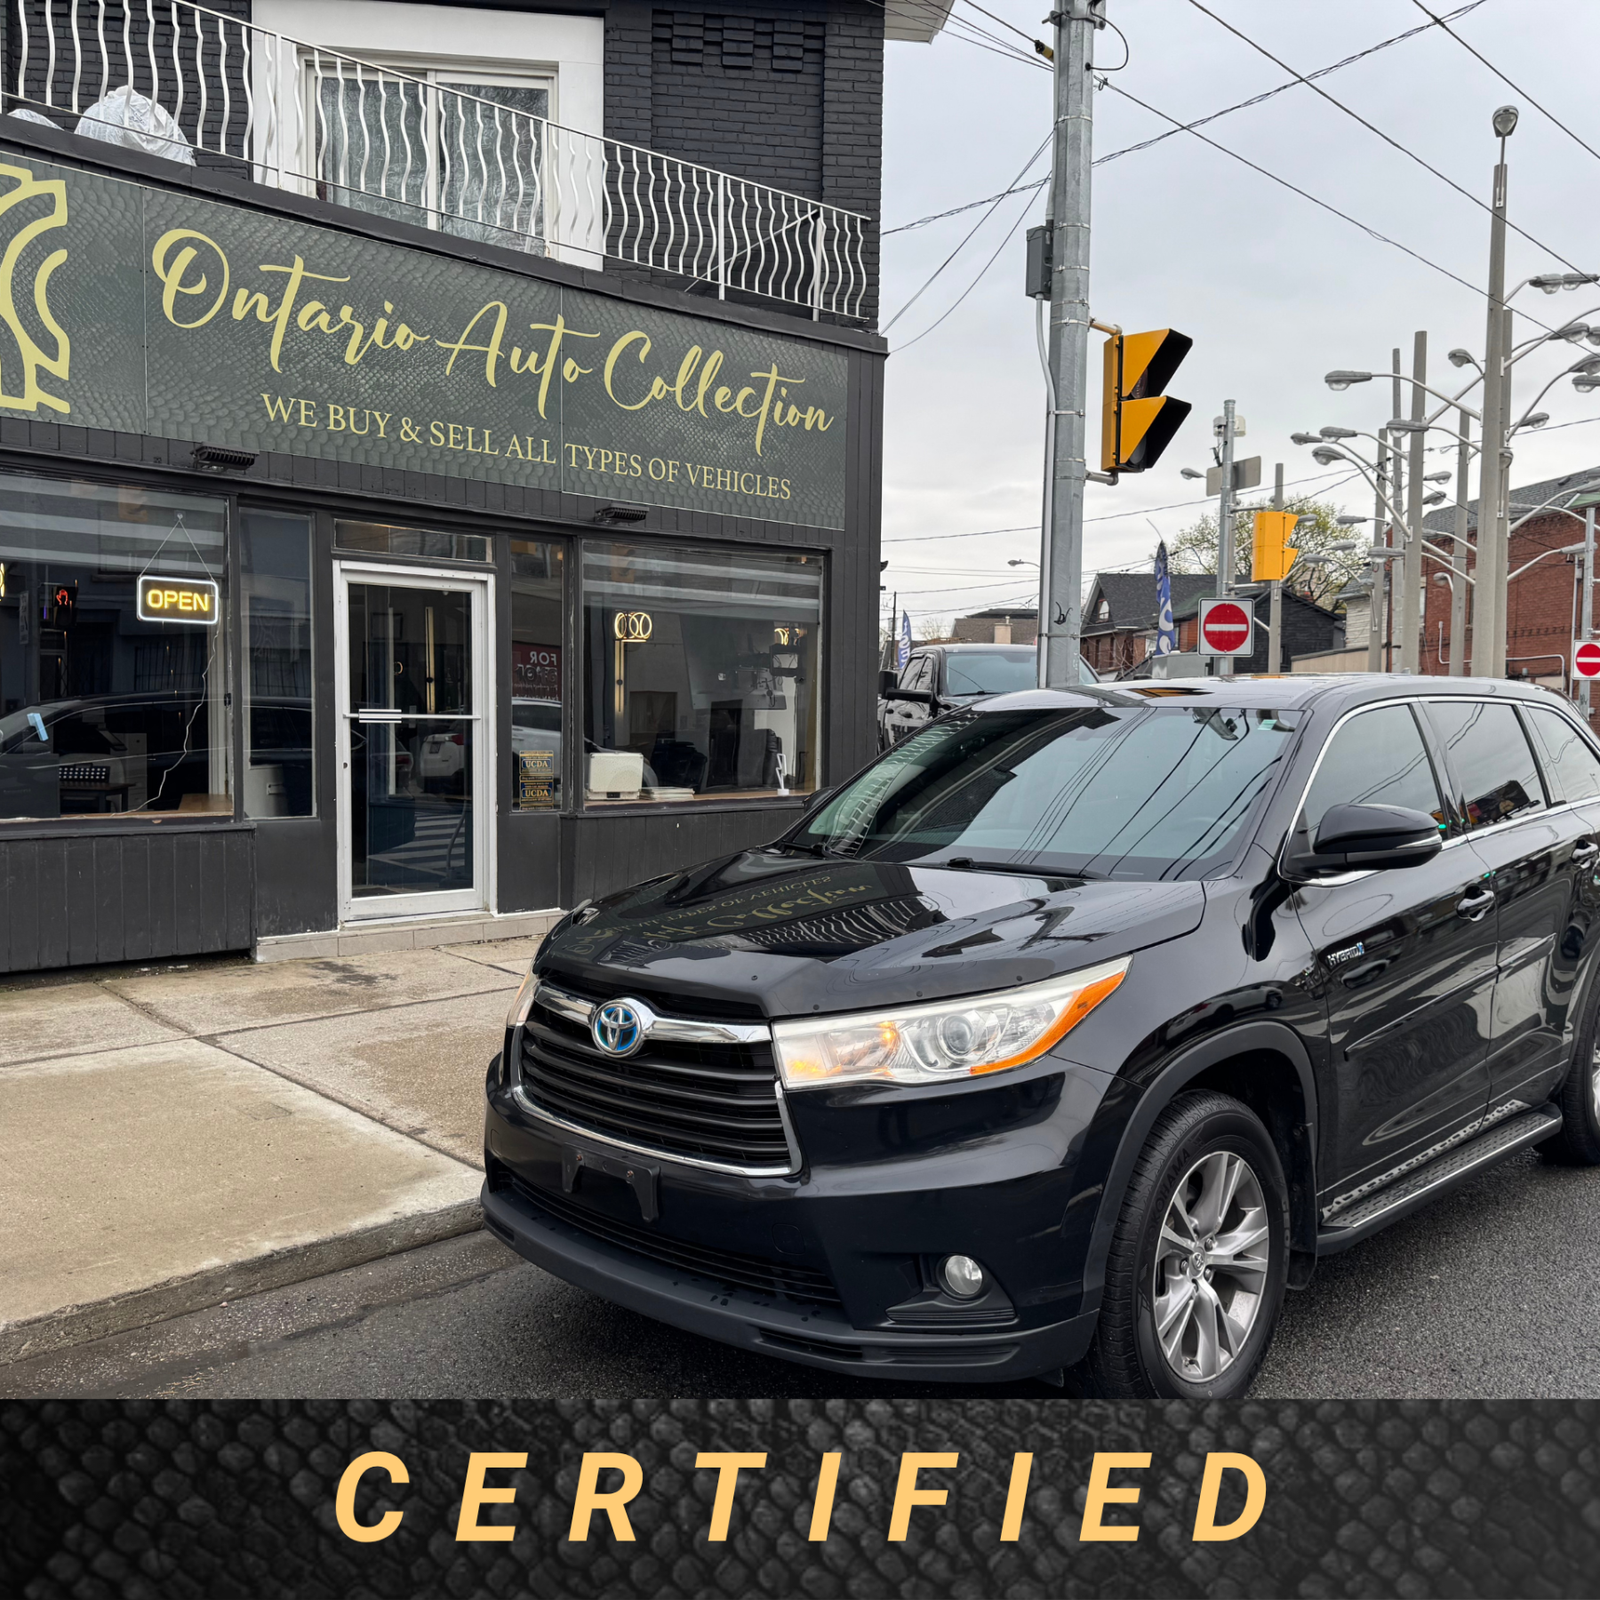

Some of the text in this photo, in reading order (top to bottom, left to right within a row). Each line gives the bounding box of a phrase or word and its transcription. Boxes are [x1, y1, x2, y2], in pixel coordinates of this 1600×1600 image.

[152, 228, 834, 457] Ontario Auto Collection
[262, 393, 791, 500] WE BUY & SELL ALL TYPES OF VEHICLES
[146, 588, 210, 612] OPEN
[525, 760, 549, 768] UCDA
[525, 789, 549, 797] UCDA
